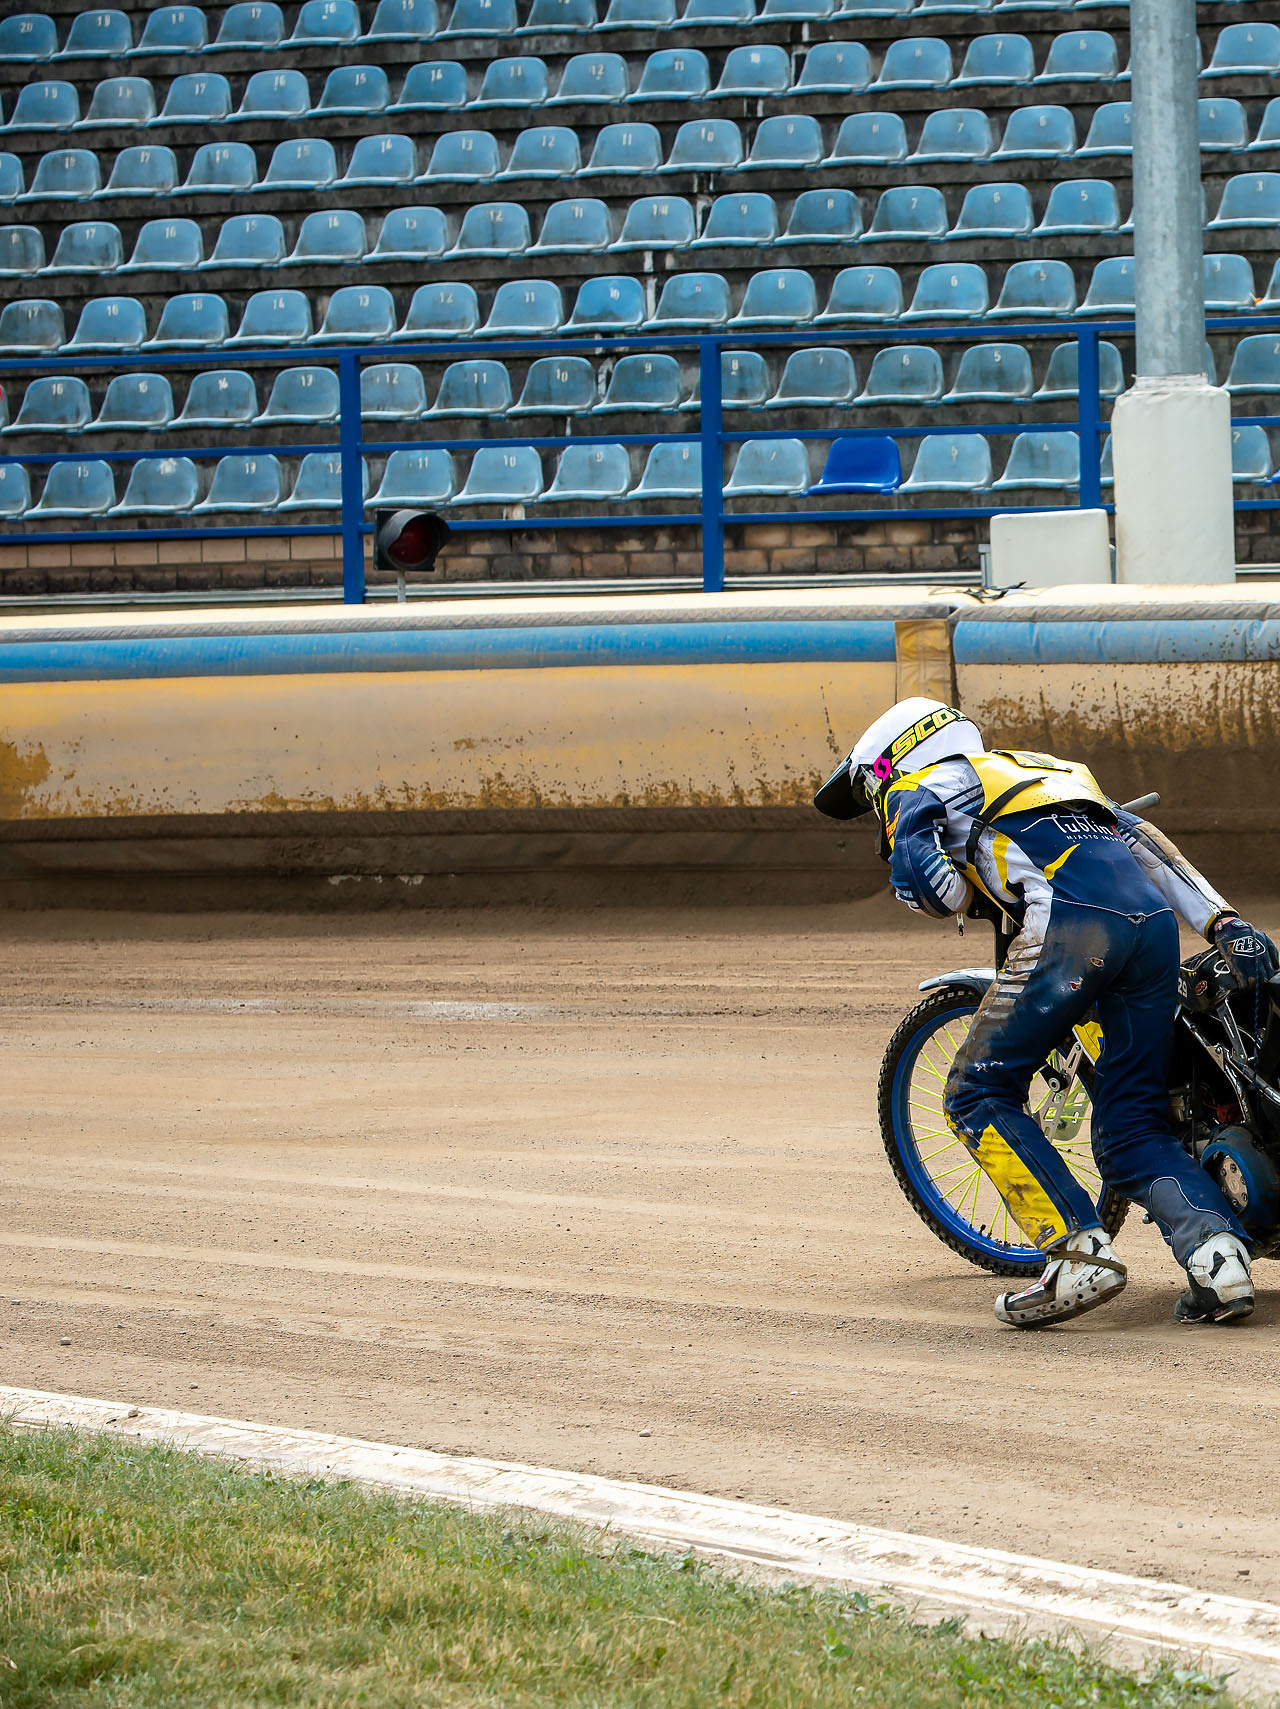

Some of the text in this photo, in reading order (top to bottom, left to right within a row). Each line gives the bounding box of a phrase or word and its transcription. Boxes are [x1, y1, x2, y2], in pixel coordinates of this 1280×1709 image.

[251, 7, 261, 18] 17
[195, 83, 206, 95] 17
[957, 121, 964, 133] 7
[622, 133, 632, 145] 11
[140, 151, 150, 163] 17
[1081, 190, 1088, 201] 5
[912, 197, 918, 209] 7
[85, 228, 96, 240] 17
[951, 275, 958, 286] 6
[273, 297, 285, 309] 14
[525, 292, 535, 302] 11
[1273, 343, 1280, 354] 2
[903, 354, 910, 365] 6
[994, 351, 1001, 362] 5
[645, 363, 652, 373] 9
[386, 372, 399, 384] 12
[474, 372, 487, 384] 11
[556, 368, 568, 382] 10
[418, 456, 428, 468] 11
[891, 708, 966, 767] SCO
